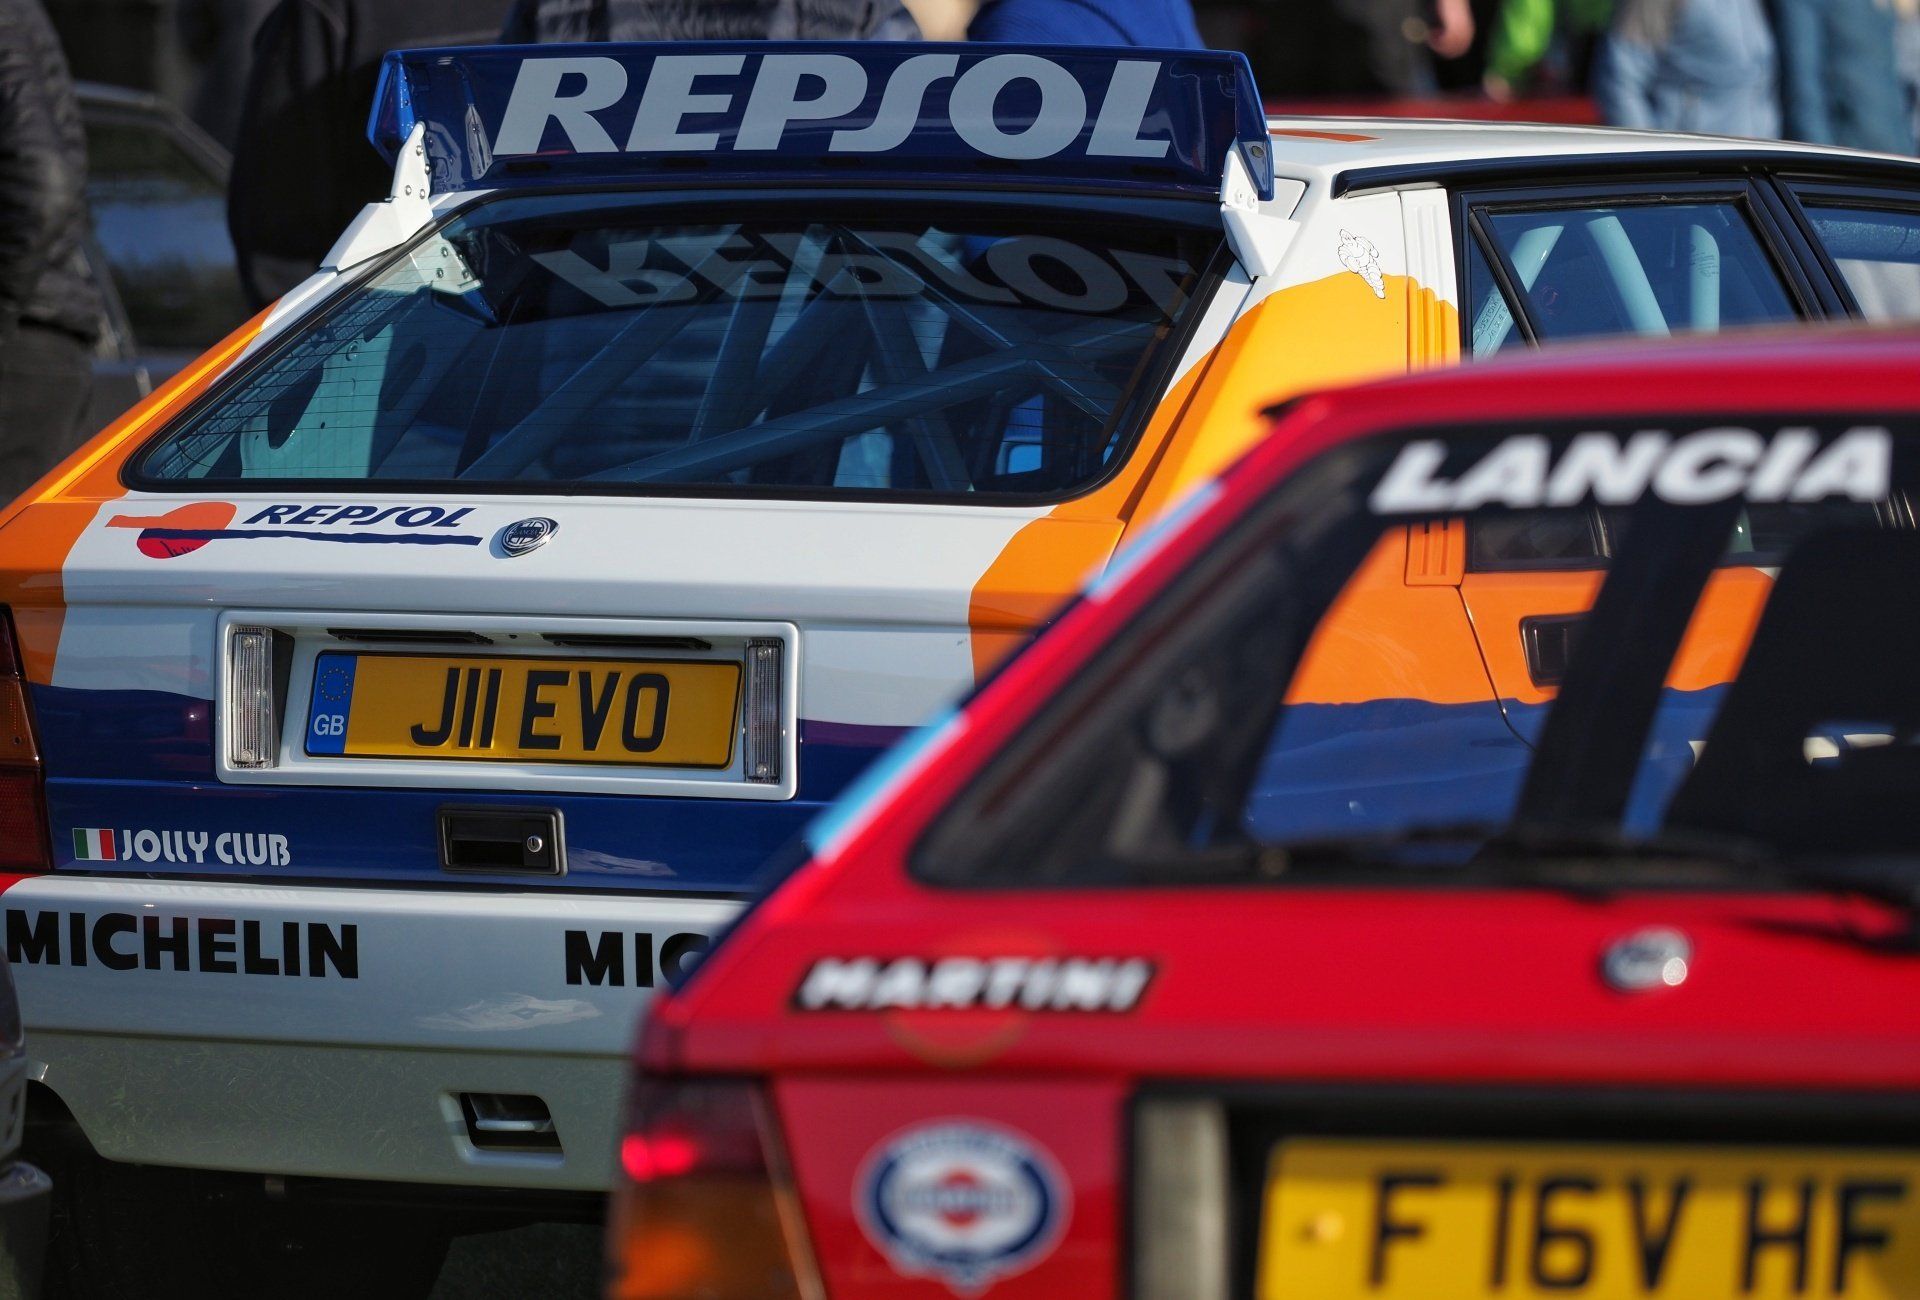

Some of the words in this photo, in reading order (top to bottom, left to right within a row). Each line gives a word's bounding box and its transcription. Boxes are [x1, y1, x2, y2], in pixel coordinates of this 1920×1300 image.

[493, 53, 1170, 160] REPSOL
[1368, 425, 1893, 513] LANCIA
[242, 504, 477, 528] REPSOL
[313, 713, 346, 737] GB
[518, 670, 669, 752] EVO
[122, 829, 209, 864] JOLLY
[215, 832, 291, 866] CLUB
[6, 909, 359, 979] MICHELIN
[799, 957, 1153, 1011] MARTINI
[1740, 1180, 1908, 1297] HF
